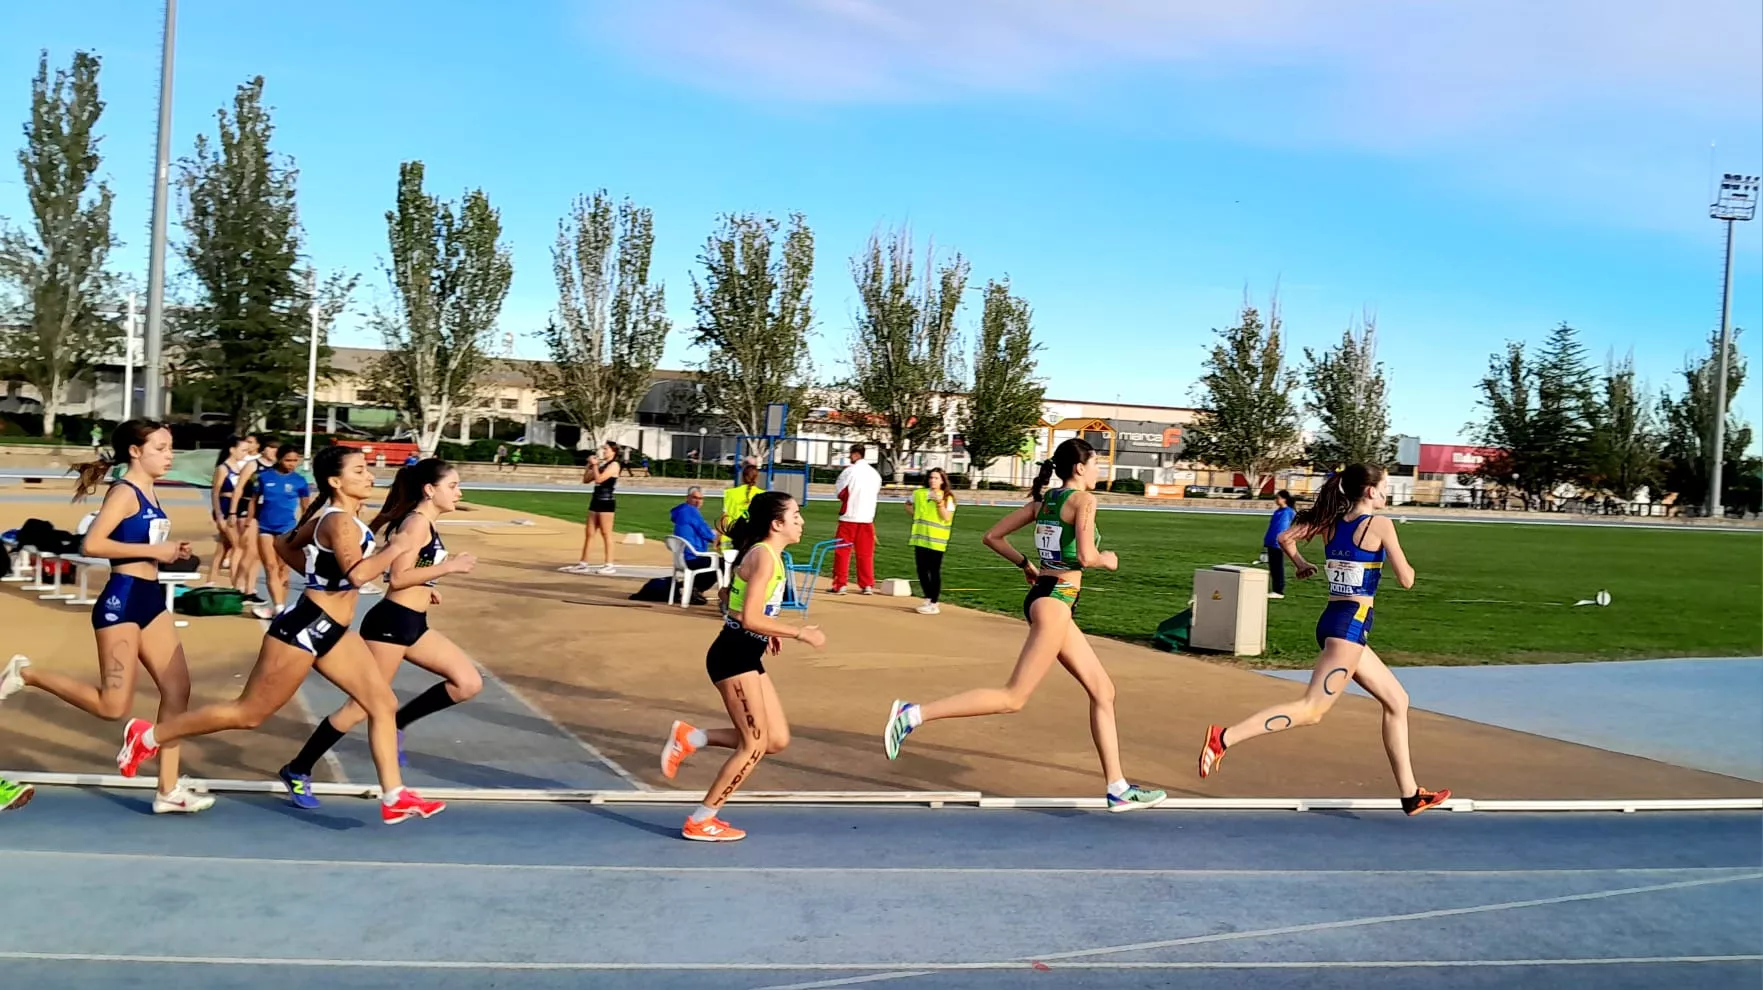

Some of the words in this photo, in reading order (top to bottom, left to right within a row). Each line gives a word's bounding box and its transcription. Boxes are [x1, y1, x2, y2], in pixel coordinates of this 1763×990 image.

[1042, 536, 1050, 548] 17
[1334, 570, 1345, 583] 21
[732, 679, 761, 741] HIRU
